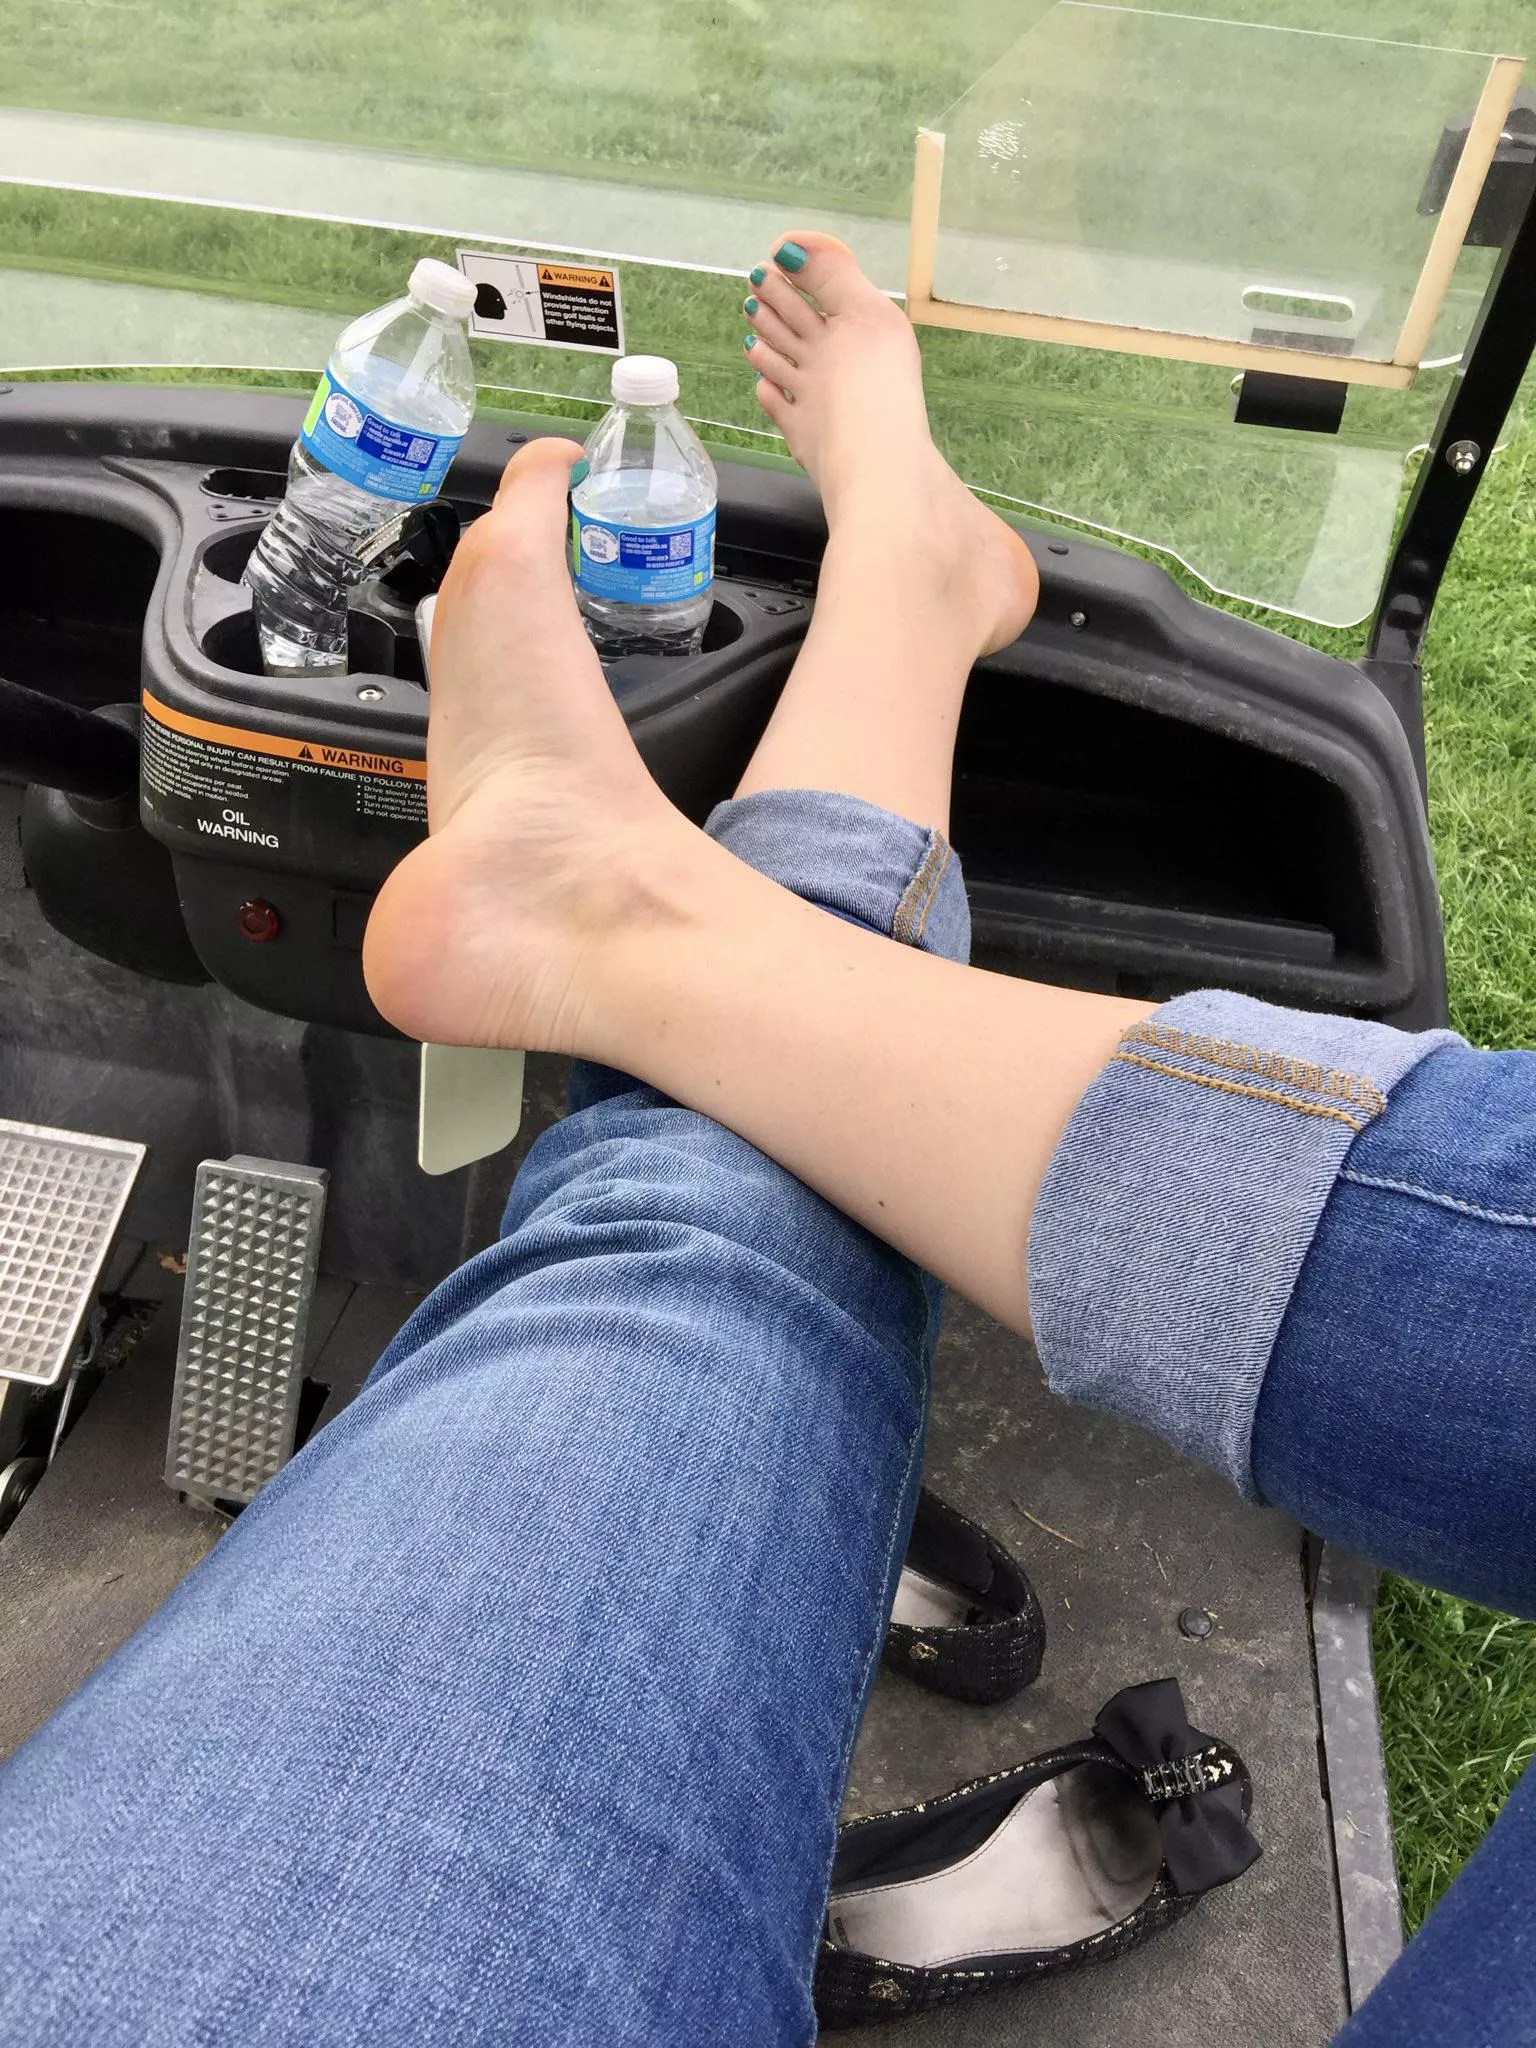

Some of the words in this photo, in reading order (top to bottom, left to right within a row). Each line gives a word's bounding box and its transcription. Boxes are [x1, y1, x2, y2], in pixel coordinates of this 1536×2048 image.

[554, 272, 598, 284] WARNING
[542, 292, 587, 303] Windshields
[543, 301, 571, 310] provide
[572, 305, 609, 314] protection
[544, 309, 562, 317] from
[545, 318, 564, 326] other
[566, 320, 587, 330] flying
[588, 323, 616, 333] objects.
[171, 733, 205, 751] PERSONAL
[207, 746, 236, 758] INJURY
[237, 752, 256, 762] CAN
[258, 756, 290, 768] RESULT
[291, 763, 318, 774] FROM
[320, 768, 356, 780] FAILURE
[359, 775, 371, 783] TO
[373, 778, 412, 790] FOLLOW
[414, 783, 426, 792] TH
[231, 760, 254, 770] before
[322, 748, 404, 774] WARNING
[222, 766, 260, 779] designated
[385, 788, 408, 798] slowly
[378, 796, 406, 805] parking
[364, 800, 380, 808] Turn
[401, 806, 427, 815] switch
[222, 808, 250, 826] OIL
[390, 812, 419, 822] operate
[197, 818, 279, 849] WARNING
